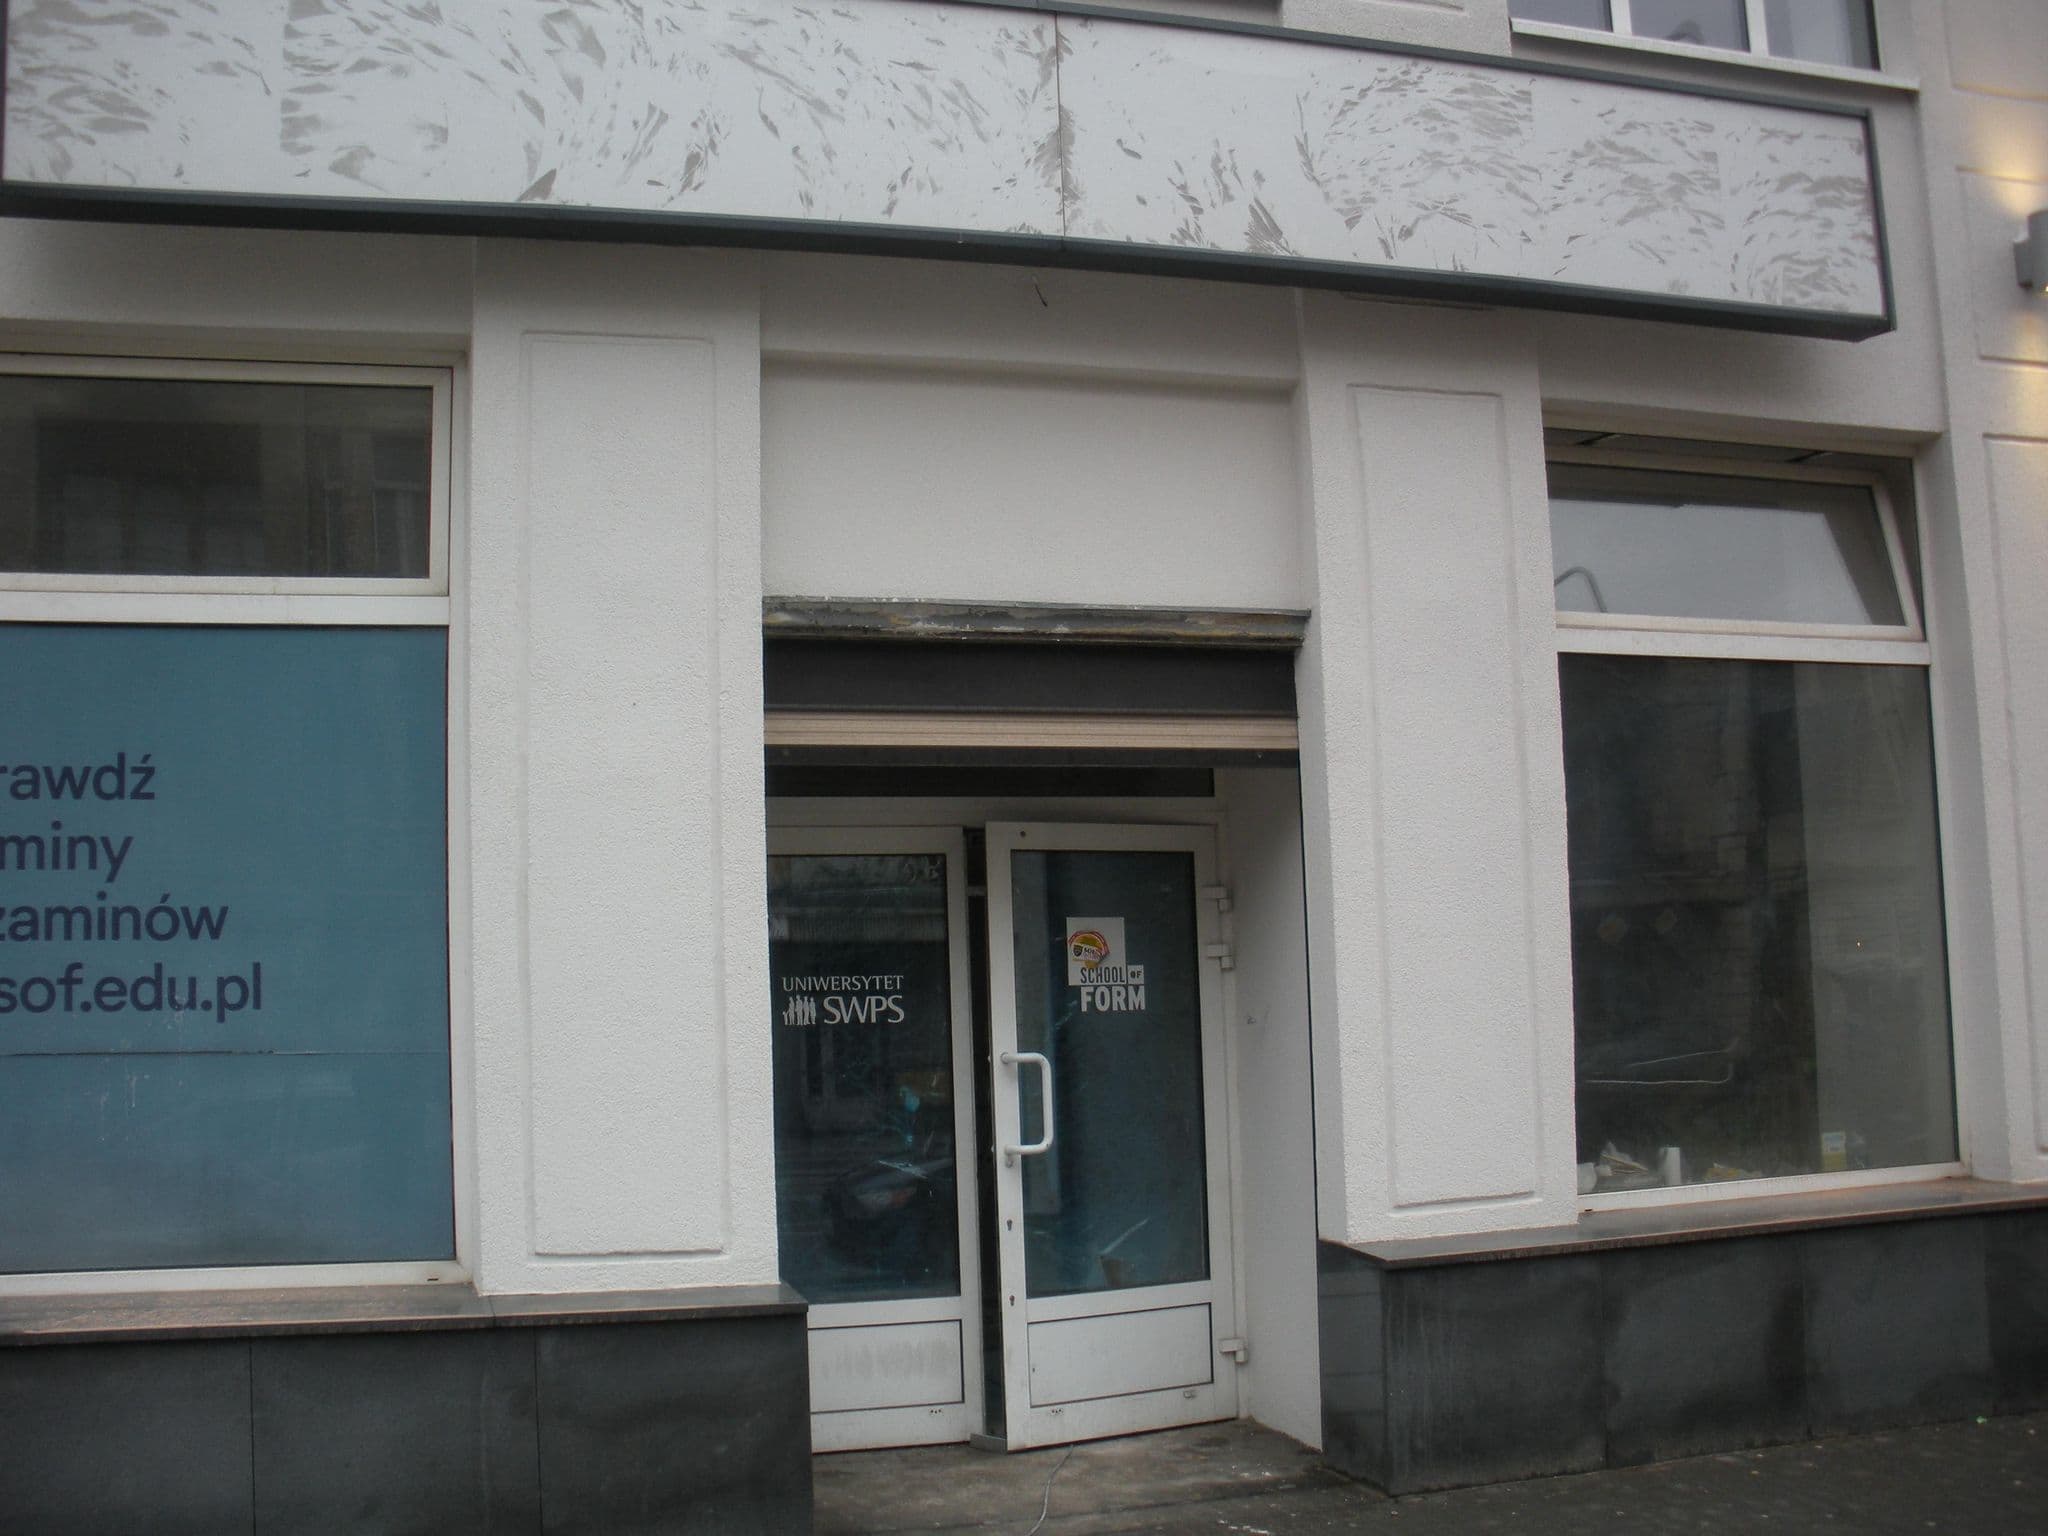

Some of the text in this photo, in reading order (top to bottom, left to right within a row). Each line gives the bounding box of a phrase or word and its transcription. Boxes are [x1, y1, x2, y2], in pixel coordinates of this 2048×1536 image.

[0, 890, 229, 942] aminów
[782, 975, 904, 992] UNIWERSYTET
[1080, 966, 1142, 984] SCHOOL OF
[0, 961, 262, 1023] sof.edu.pl
[1080, 985, 1146, 1012] FORM
[823, 995, 905, 1025] SWPS
